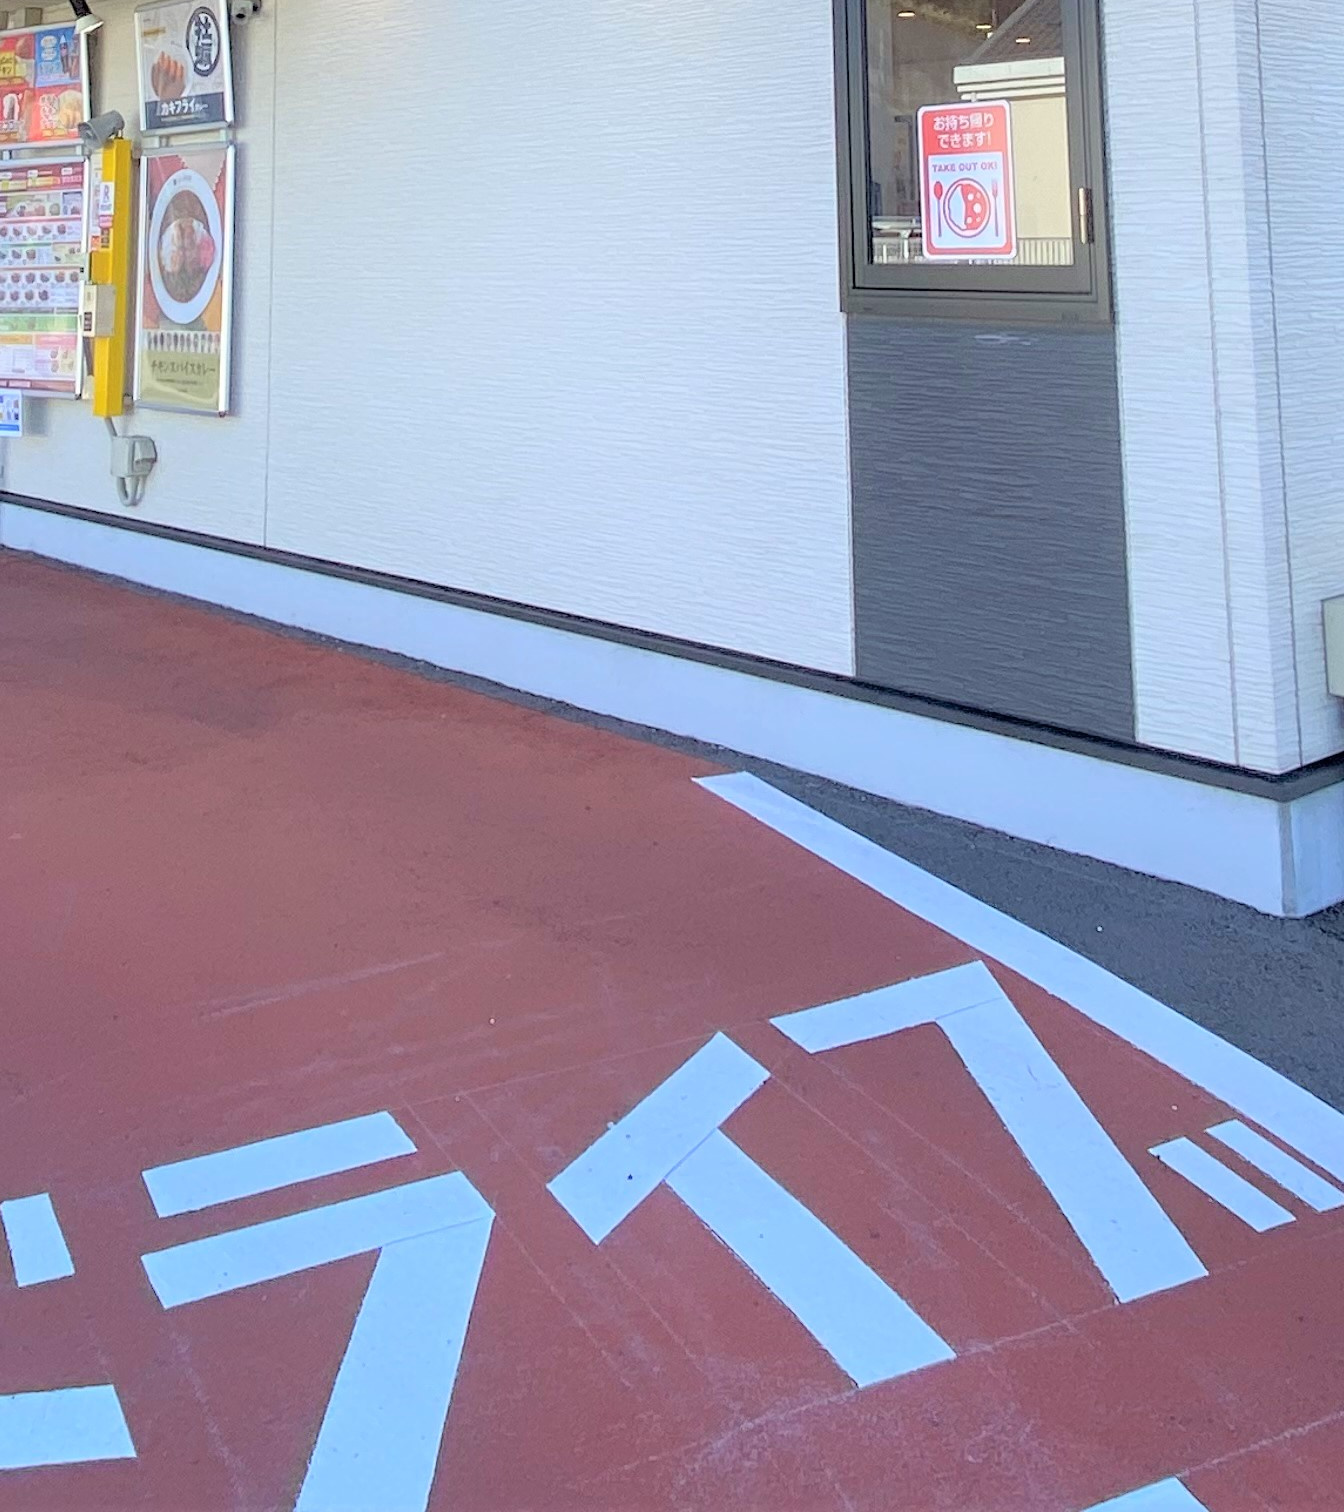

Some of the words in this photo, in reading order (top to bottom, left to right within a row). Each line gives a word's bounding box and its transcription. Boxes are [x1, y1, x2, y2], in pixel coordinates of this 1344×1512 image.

[933, 112, 994, 131] お持ち帰り
[932, 163, 956, 172] TAKE
[958, 162, 978, 172] OUT
